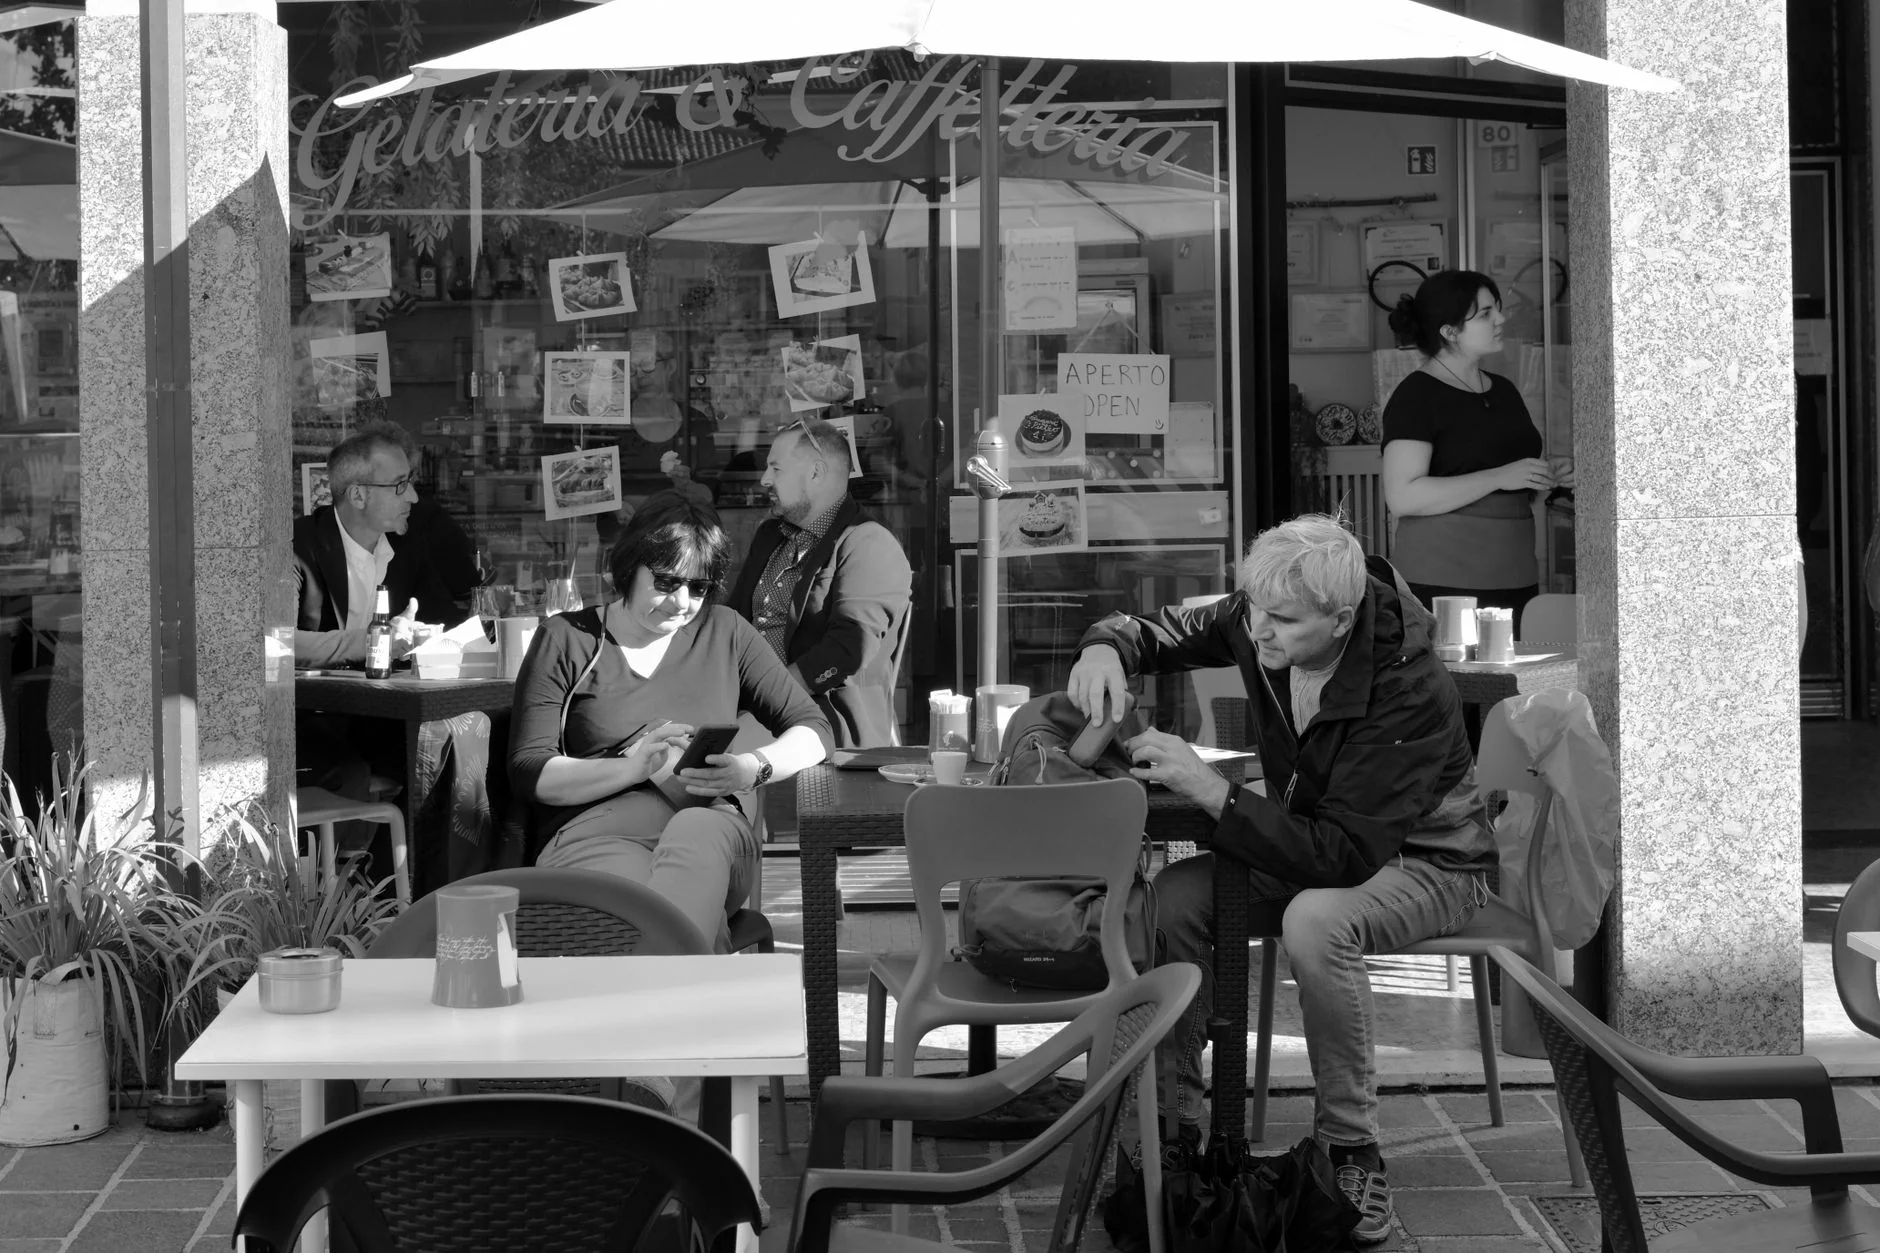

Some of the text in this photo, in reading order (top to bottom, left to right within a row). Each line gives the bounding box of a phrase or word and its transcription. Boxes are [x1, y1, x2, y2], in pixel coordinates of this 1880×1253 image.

[290, 51, 1190, 230] Gelateria & Caffetteria
[1482, 126, 1511, 142] 80
[1066, 362, 1165, 386] APERTO
